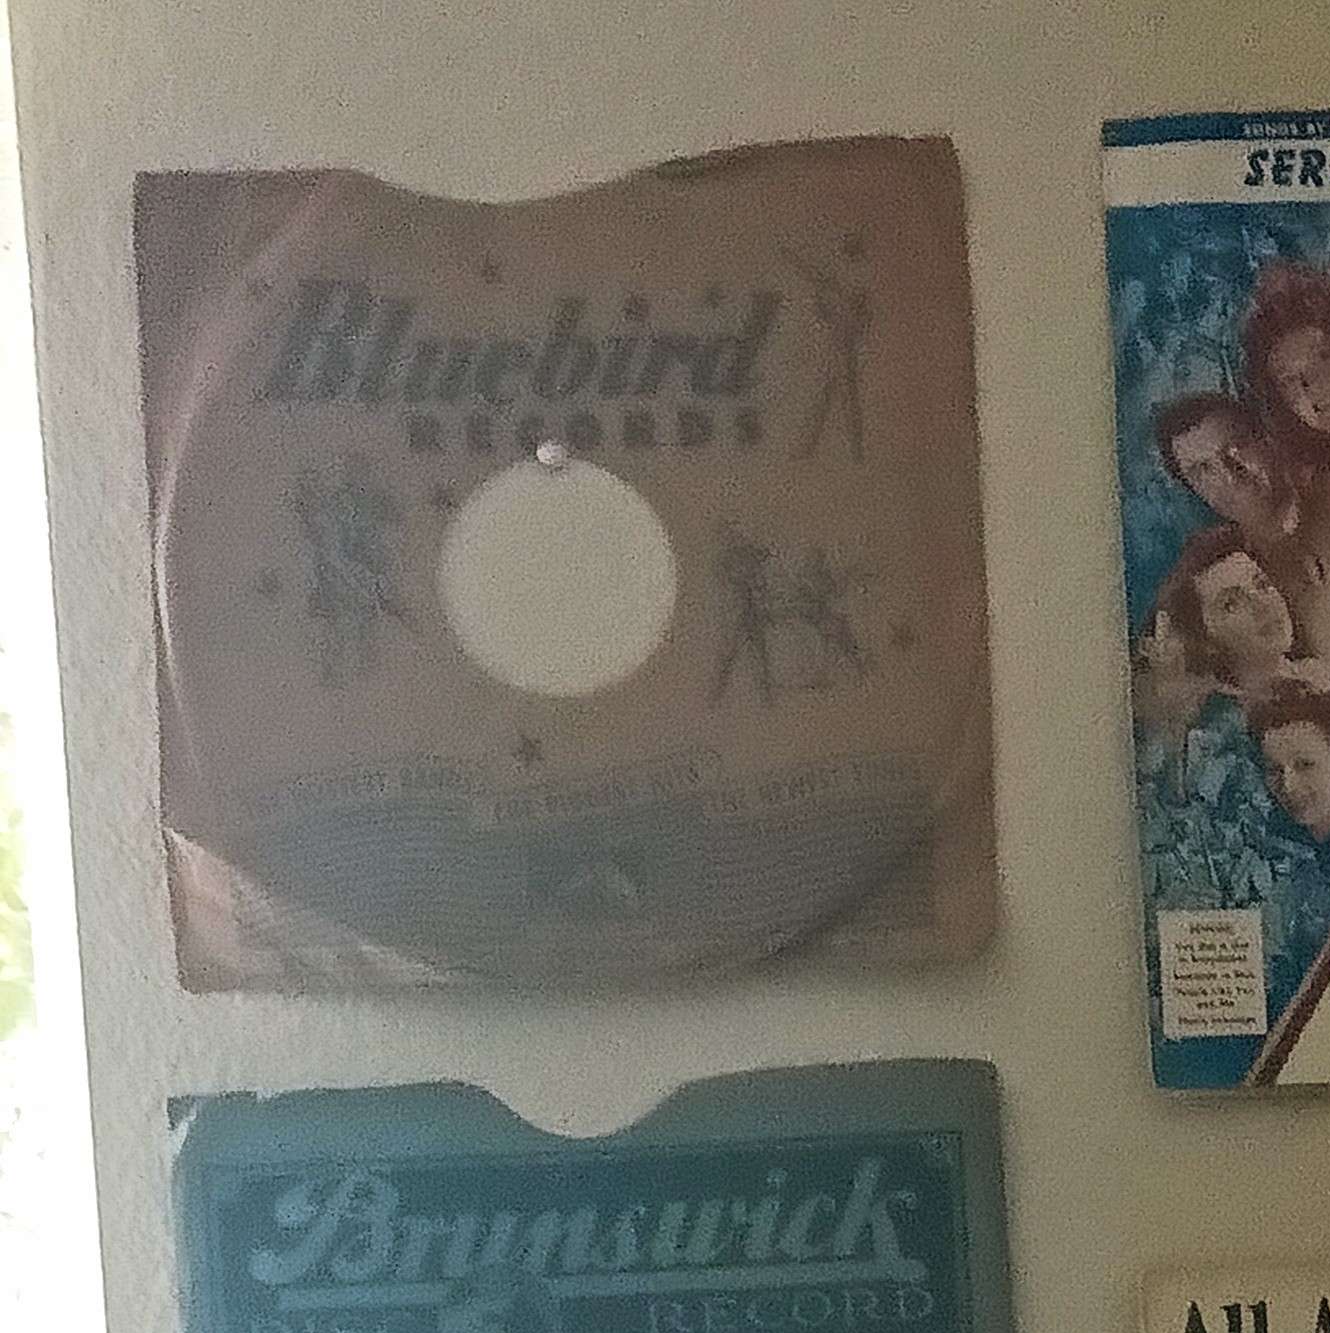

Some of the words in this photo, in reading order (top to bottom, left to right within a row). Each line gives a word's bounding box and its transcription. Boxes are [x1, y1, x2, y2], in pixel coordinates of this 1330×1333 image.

[256, 277, 783, 406] Bluebird
[405, 406, 764, 456] RECORDS
[249, 1157, 924, 1286] Brunswick
